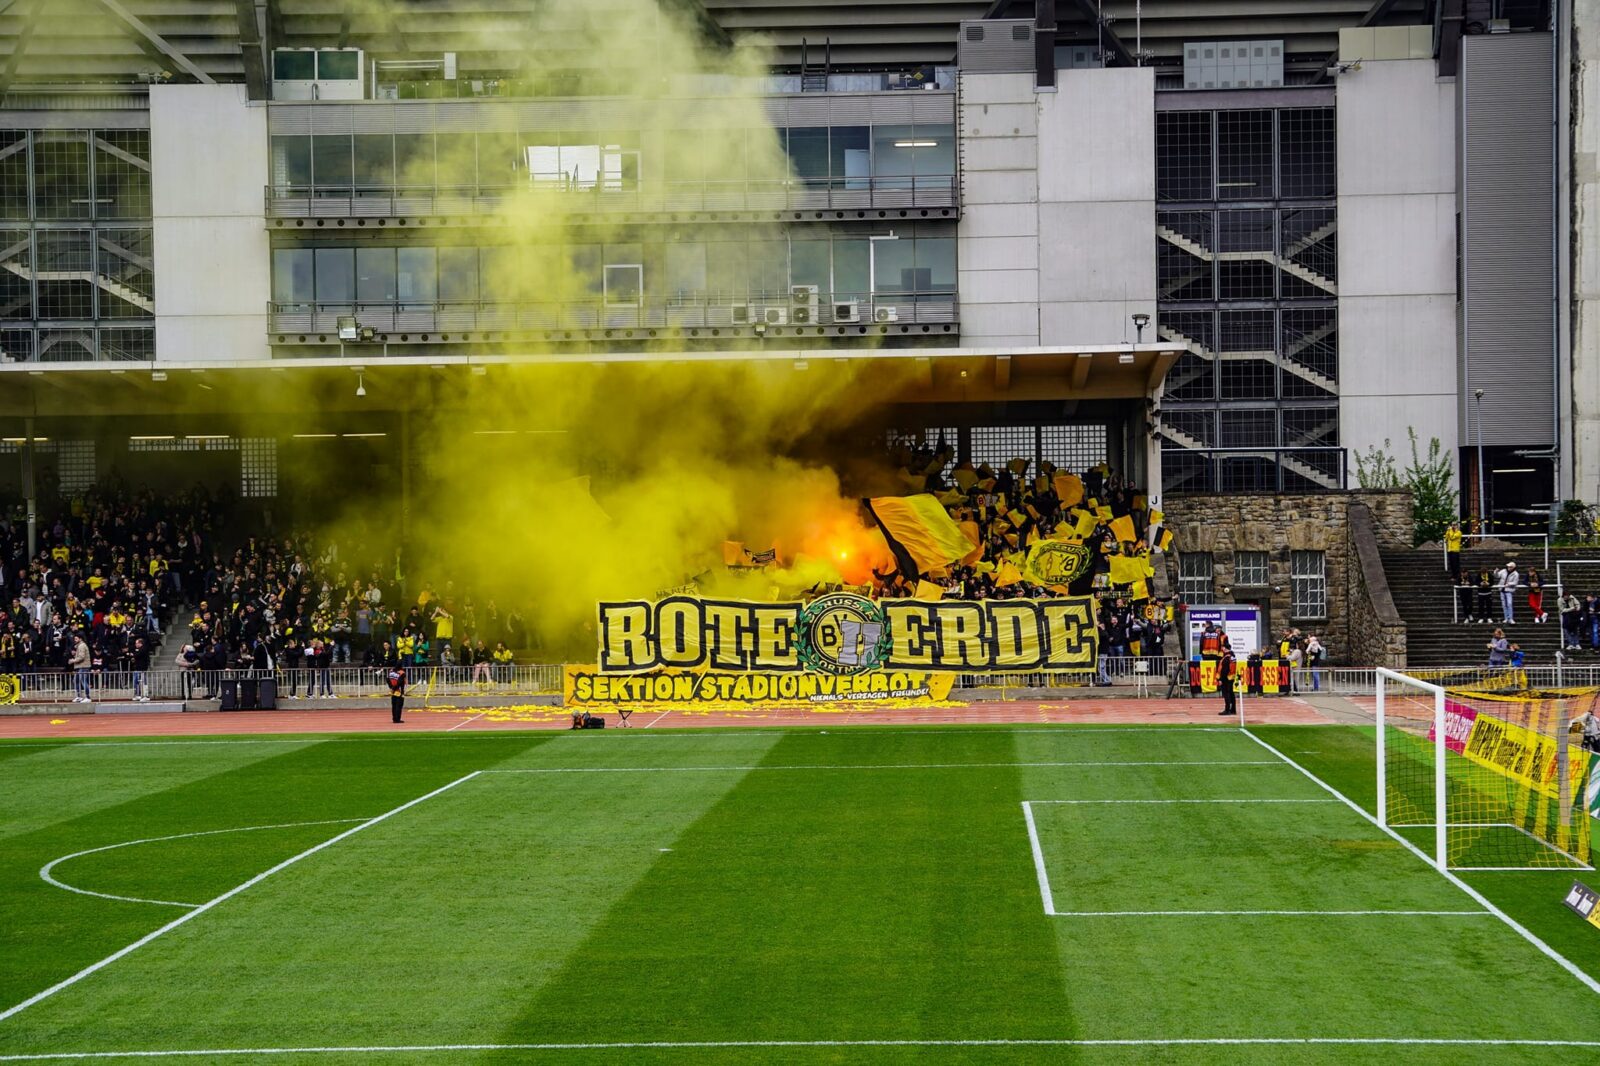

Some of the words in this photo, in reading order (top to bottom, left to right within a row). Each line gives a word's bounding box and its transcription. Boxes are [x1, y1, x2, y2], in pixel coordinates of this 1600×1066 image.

[1152, 496, 1158, 505] J
[27, 513, 35, 522] F
[600, 597, 802, 671] ROTE
[882, 597, 1096, 671] ERDE
[574, 671, 693, 701] SEKTION
[700, 669, 927, 701] STADIONVERBOT
[1259, 666, 1289, 687] ESSEN
[810, 694, 843, 702] NIEMALS
[847, 692, 888, 700] VERZAGEN
[891, 689, 930, 698] FREUNDE!
